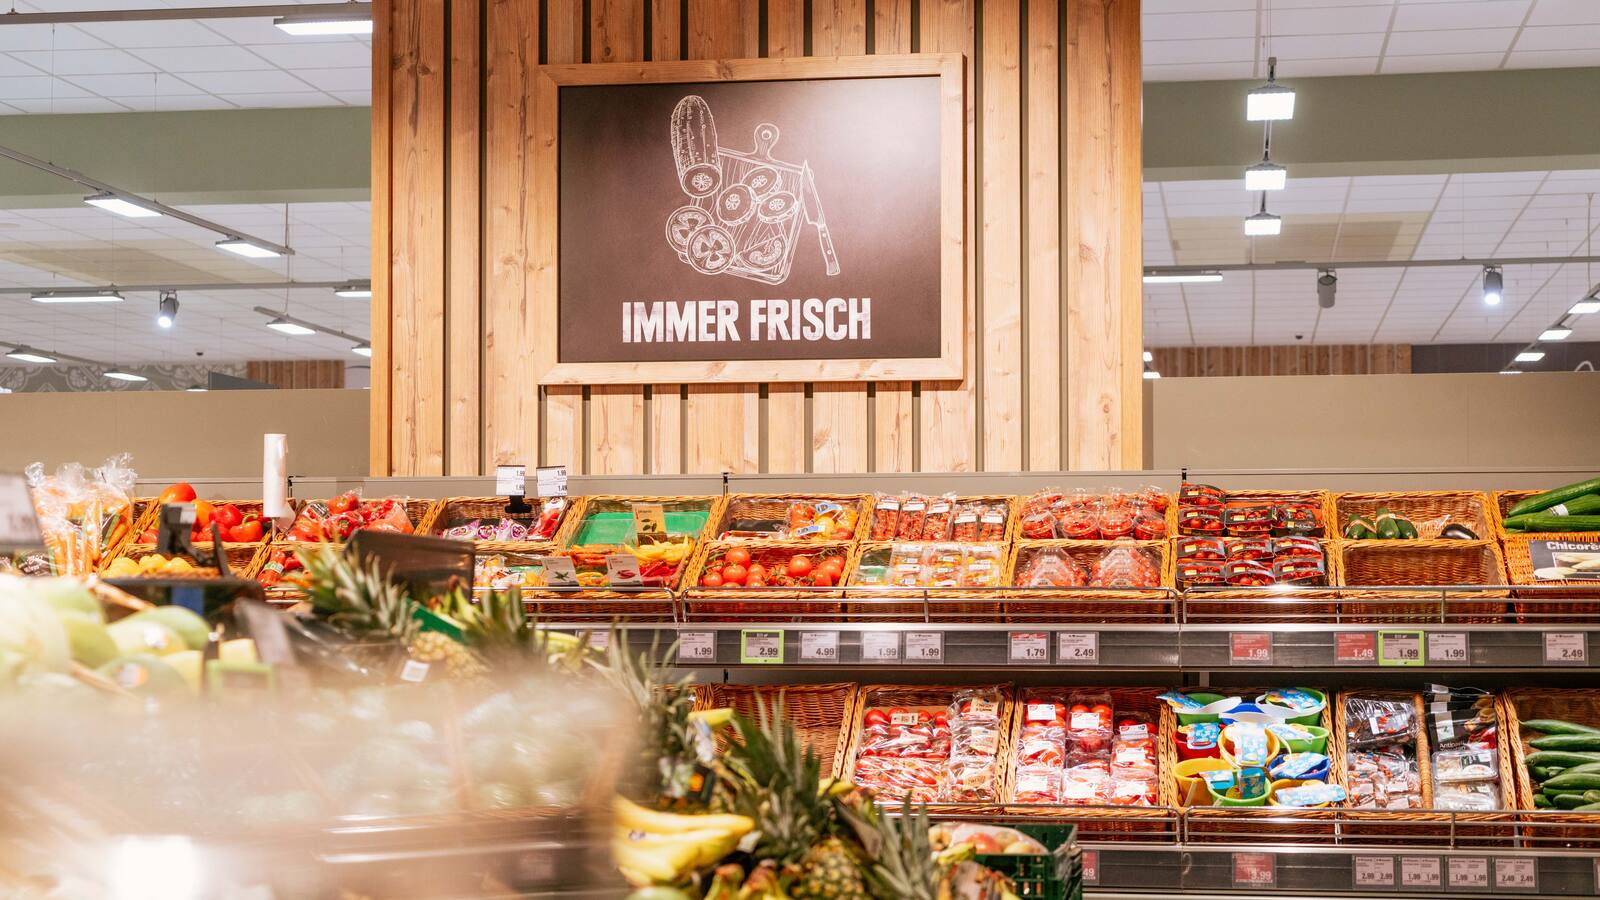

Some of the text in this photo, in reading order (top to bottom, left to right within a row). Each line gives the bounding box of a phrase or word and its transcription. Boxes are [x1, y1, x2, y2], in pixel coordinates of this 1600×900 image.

[622, 297, 871, 343] IMMER FRISCH
[1546, 541, 1600, 550] Chicoré
[694, 647, 712, 655] 1.99
[759, 647, 778, 656] 2.99
[816, 648, 835, 656] 4.99
[878, 647, 897, 656] 1.99
[921, 648, 940, 656] 1.99
[1025, 648, 1045, 656] 1.79
[1074, 648, 1094, 657] 2.49
[1248, 649, 1268, 657] 1.99
[1352, 648, 1374, 657] 1.49
[1399, 649, 1418, 658] 1.99
[1445, 649, 1465, 658] 1.99
[1562, 649, 1583, 658] 2.49
[1426, 873, 1439, 881] 1.99
